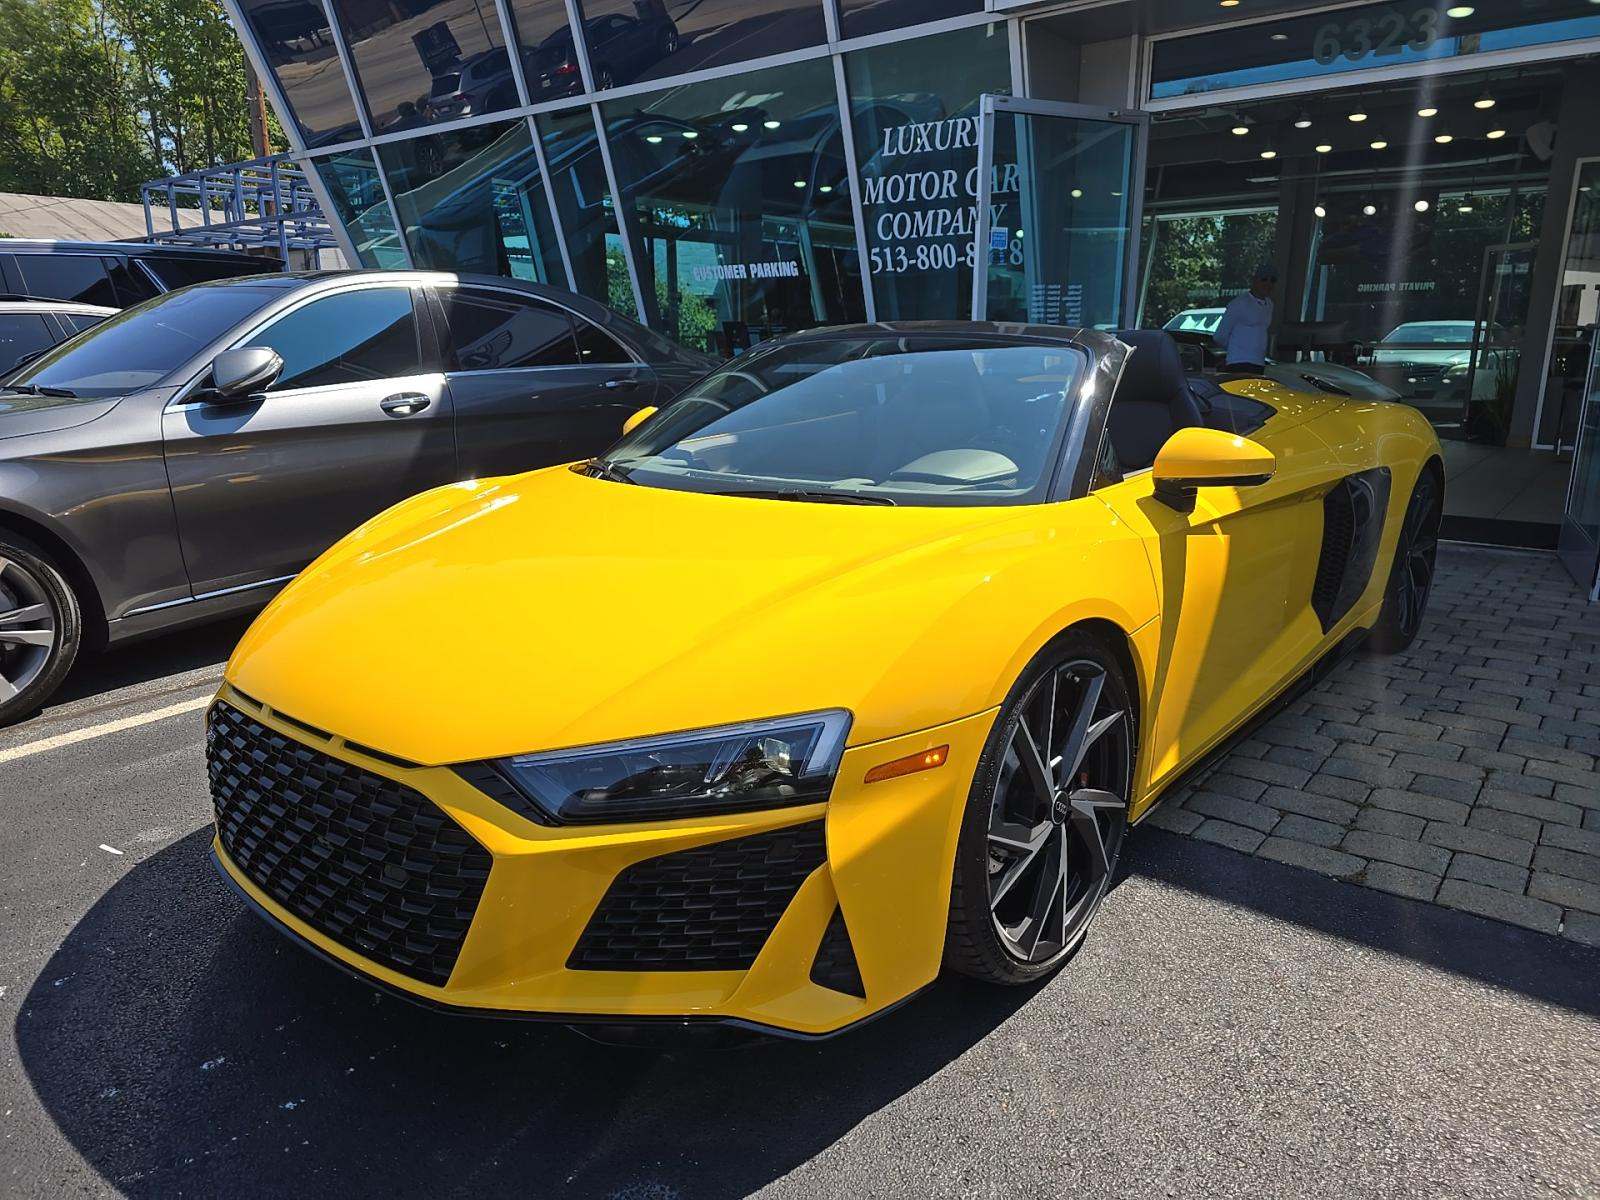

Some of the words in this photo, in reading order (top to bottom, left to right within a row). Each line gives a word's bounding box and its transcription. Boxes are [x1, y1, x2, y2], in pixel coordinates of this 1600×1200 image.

[1313, 7, 1440, 66] 6323
[863, 169, 958, 205] MOTOR
[693, 263, 747, 281] CUSTOMER
[749, 260, 799, 279] PARKING
